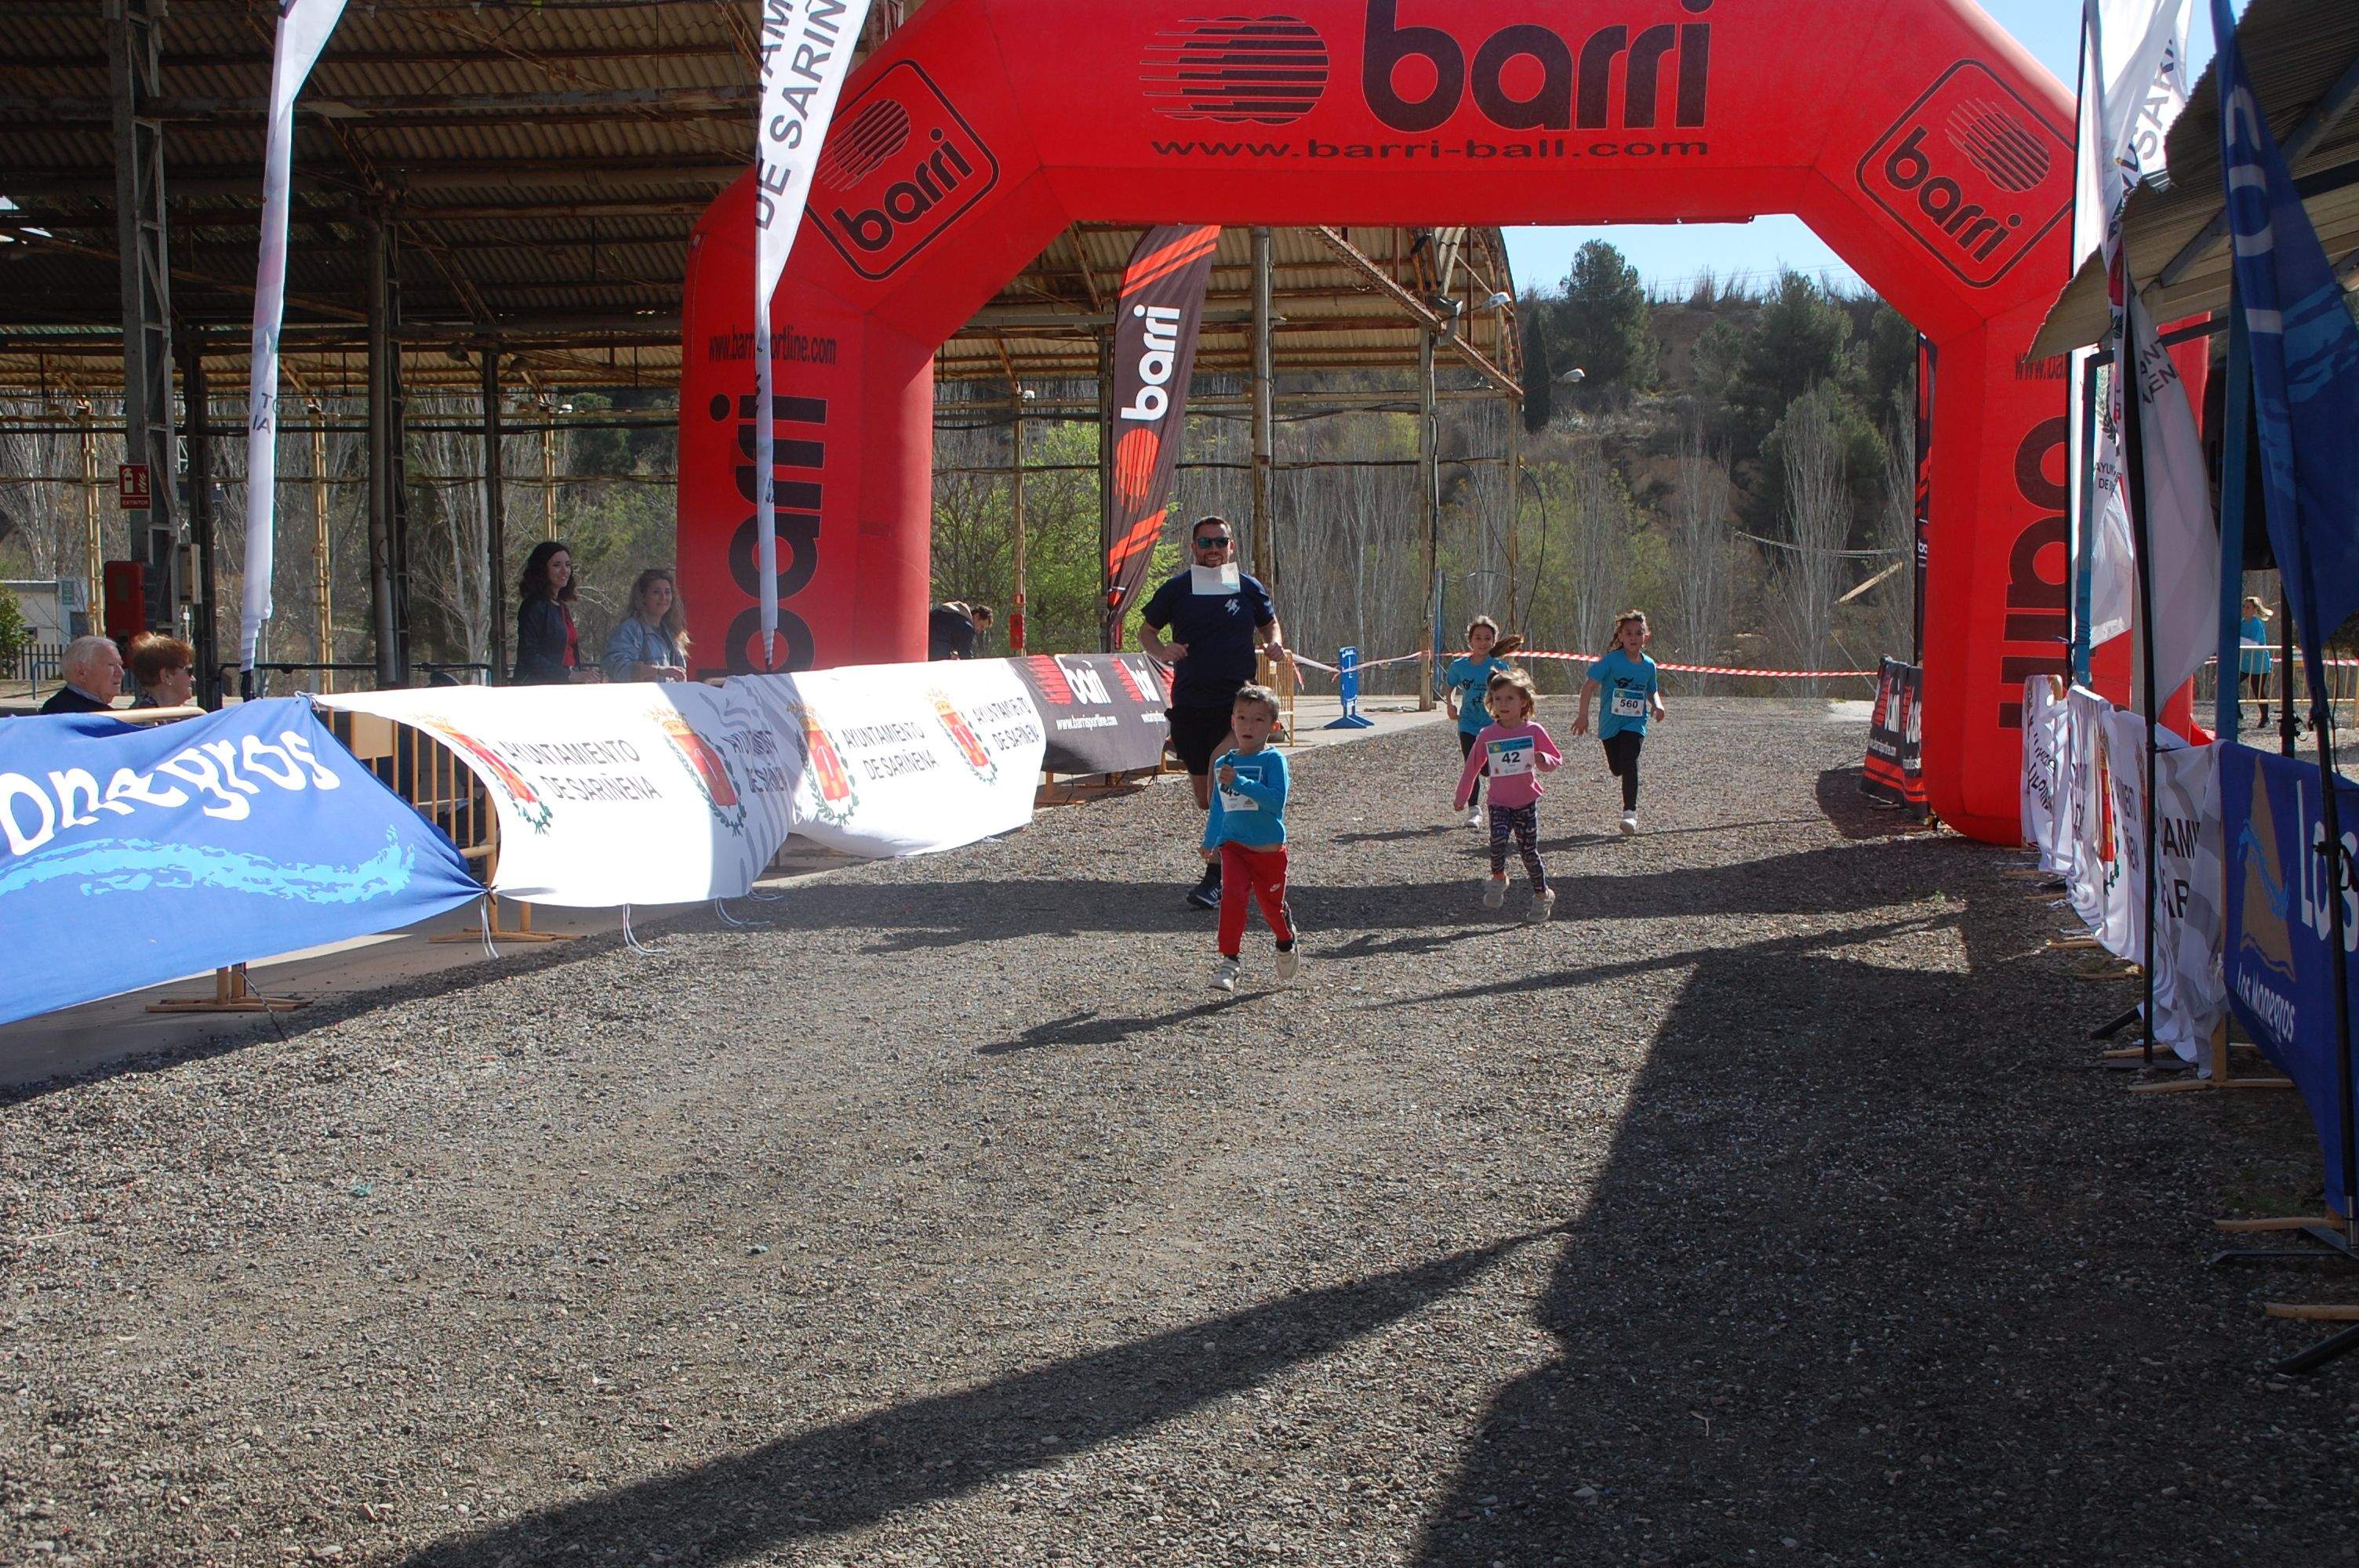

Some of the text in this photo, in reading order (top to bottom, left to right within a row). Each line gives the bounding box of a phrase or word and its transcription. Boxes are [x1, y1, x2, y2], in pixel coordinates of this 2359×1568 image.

[1362, 0, 1711, 133] barri
[832, 128, 973, 252] barri
[1150, 138, 1710, 159] www.barri-ball.com
[1884, 125, 2023, 264] barri
[1120, 305, 1181, 423] barri
[1501, 751, 1521, 764] 42
[1619, 699, 1639, 709] 560
